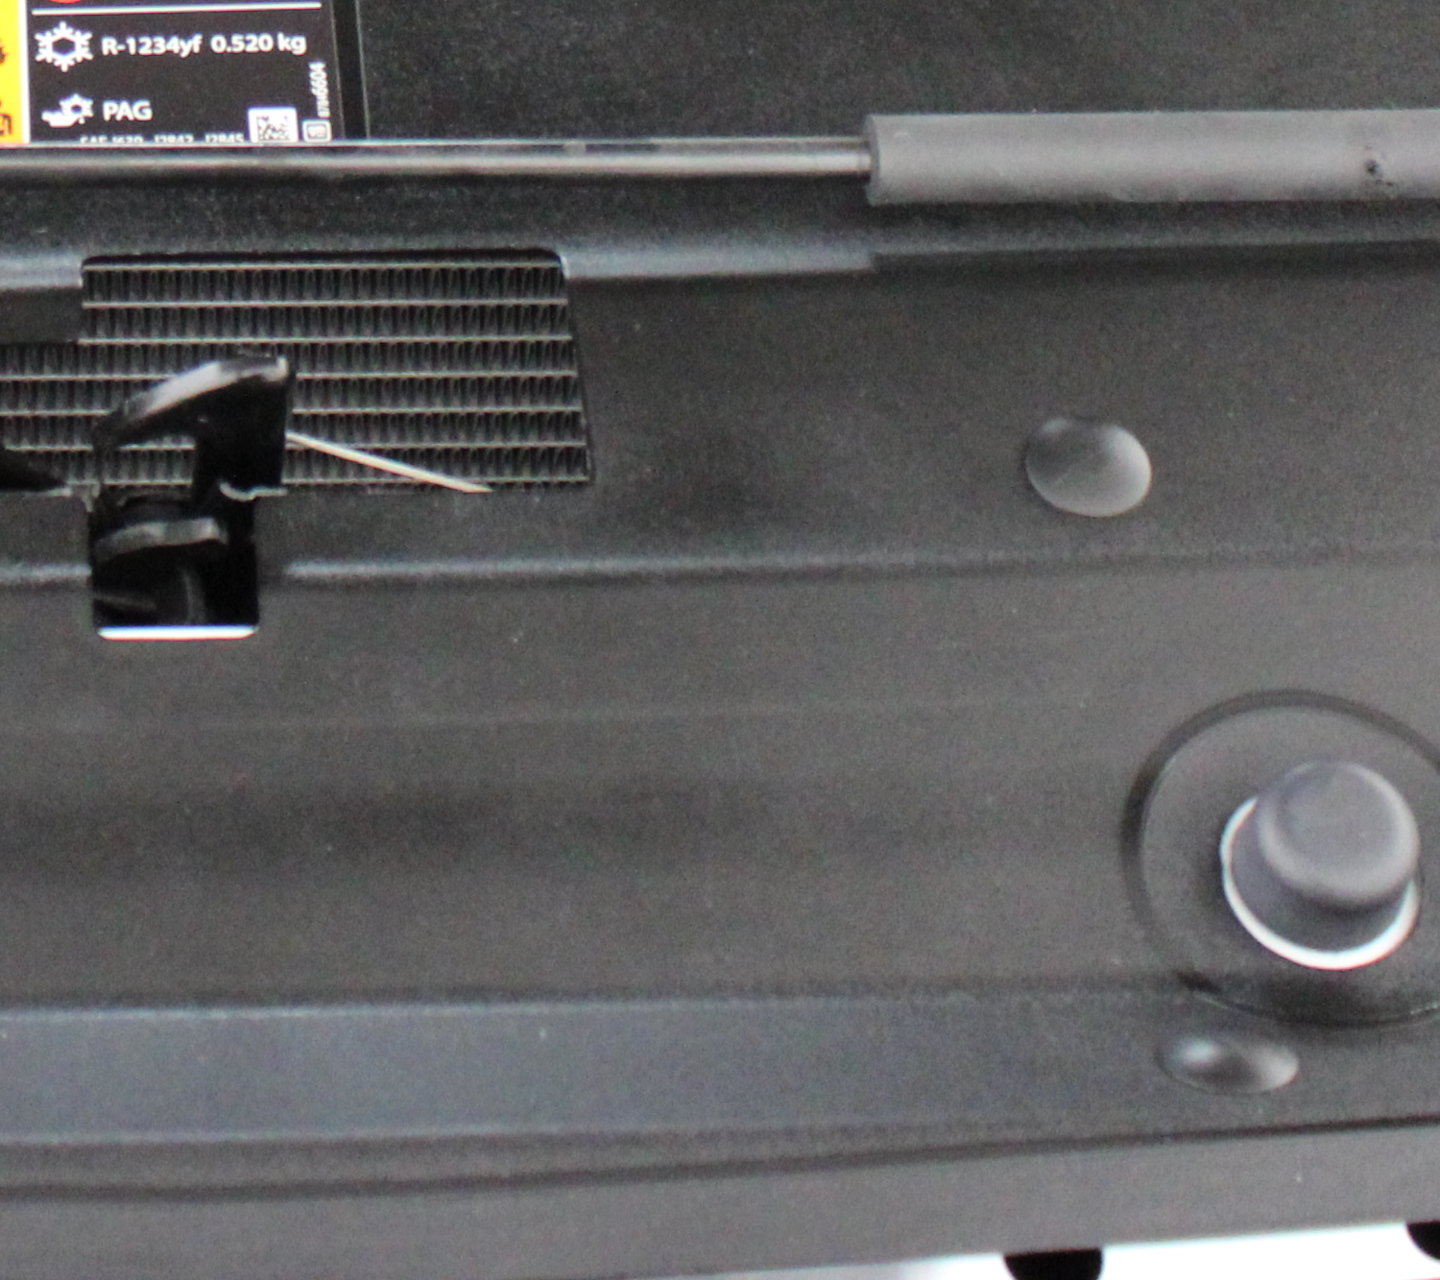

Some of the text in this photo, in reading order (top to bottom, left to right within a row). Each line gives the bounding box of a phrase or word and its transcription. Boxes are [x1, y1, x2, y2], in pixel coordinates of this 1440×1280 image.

[101, 33, 307, 57] R-1234yf 0.520 kg
[102, 100, 153, 122] PAG
